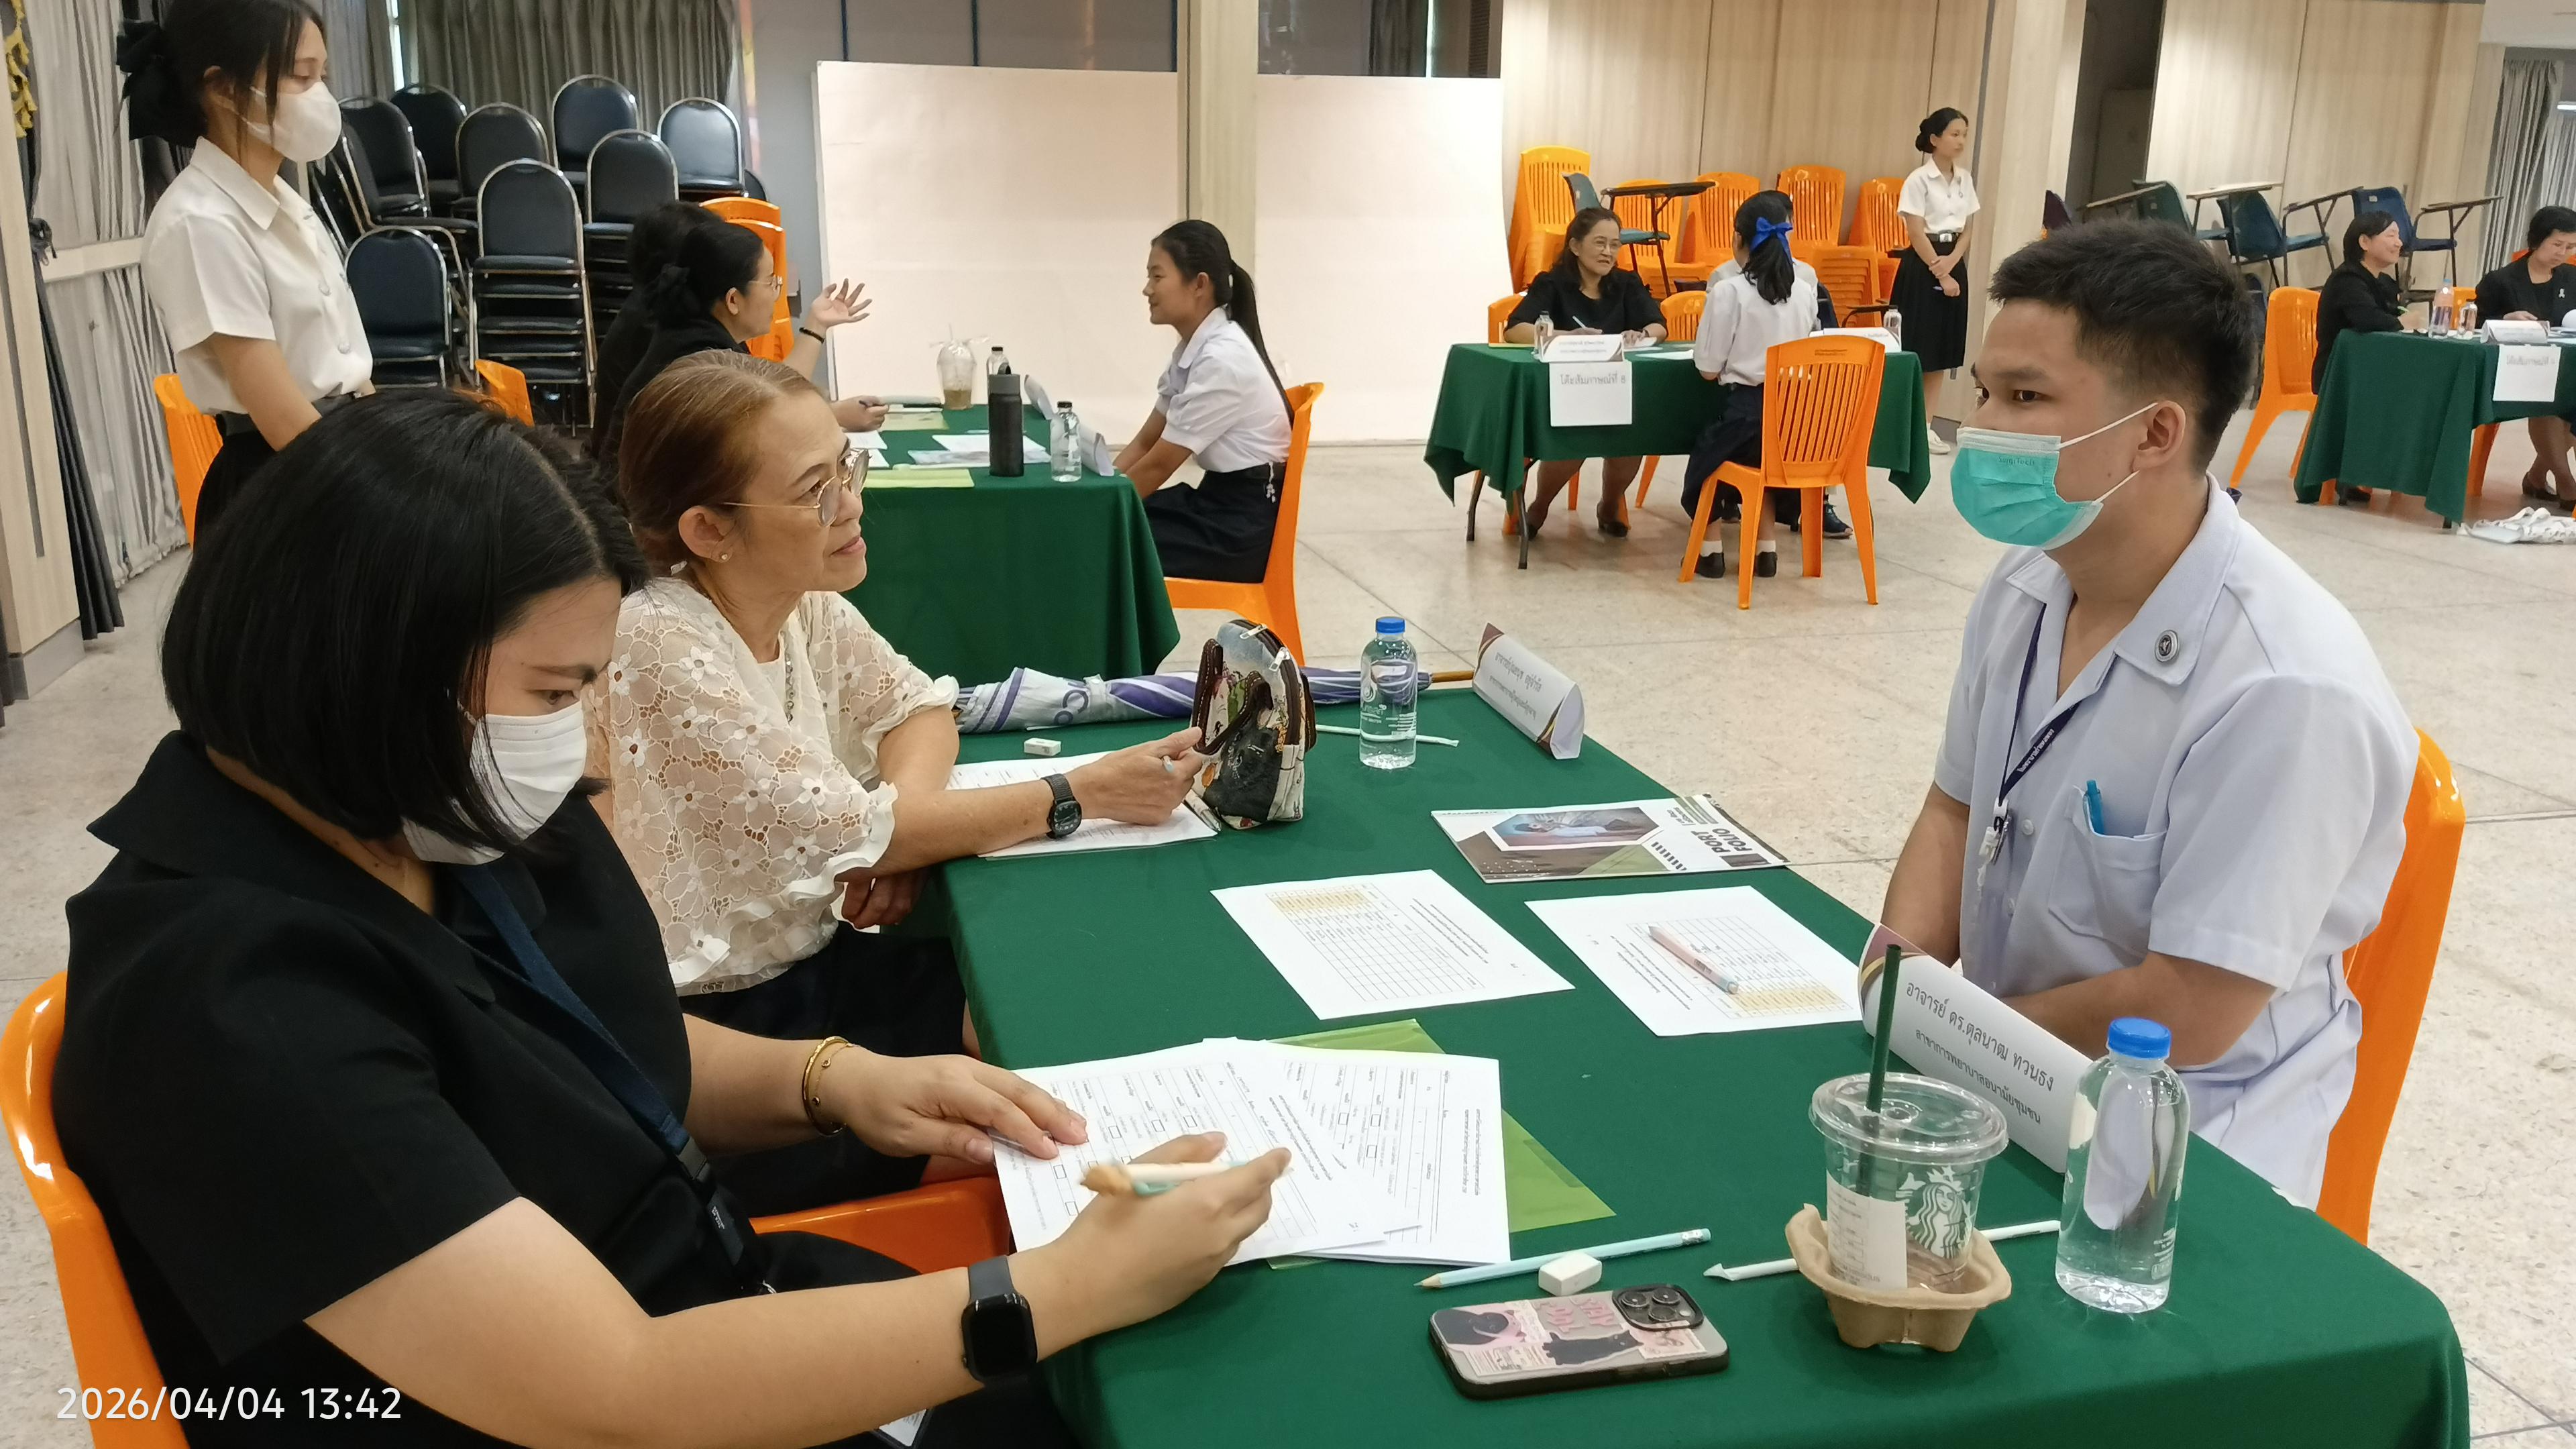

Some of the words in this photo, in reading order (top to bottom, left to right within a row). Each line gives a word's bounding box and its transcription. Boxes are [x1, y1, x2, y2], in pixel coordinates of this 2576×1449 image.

[1690, 830, 1731, 853] PORT
[1712, 828, 1753, 852] FOLIO
[1907, 982, 1949, 1018] อาจารย์
[2013, 1053, 2054, 1091] ทวนธง
